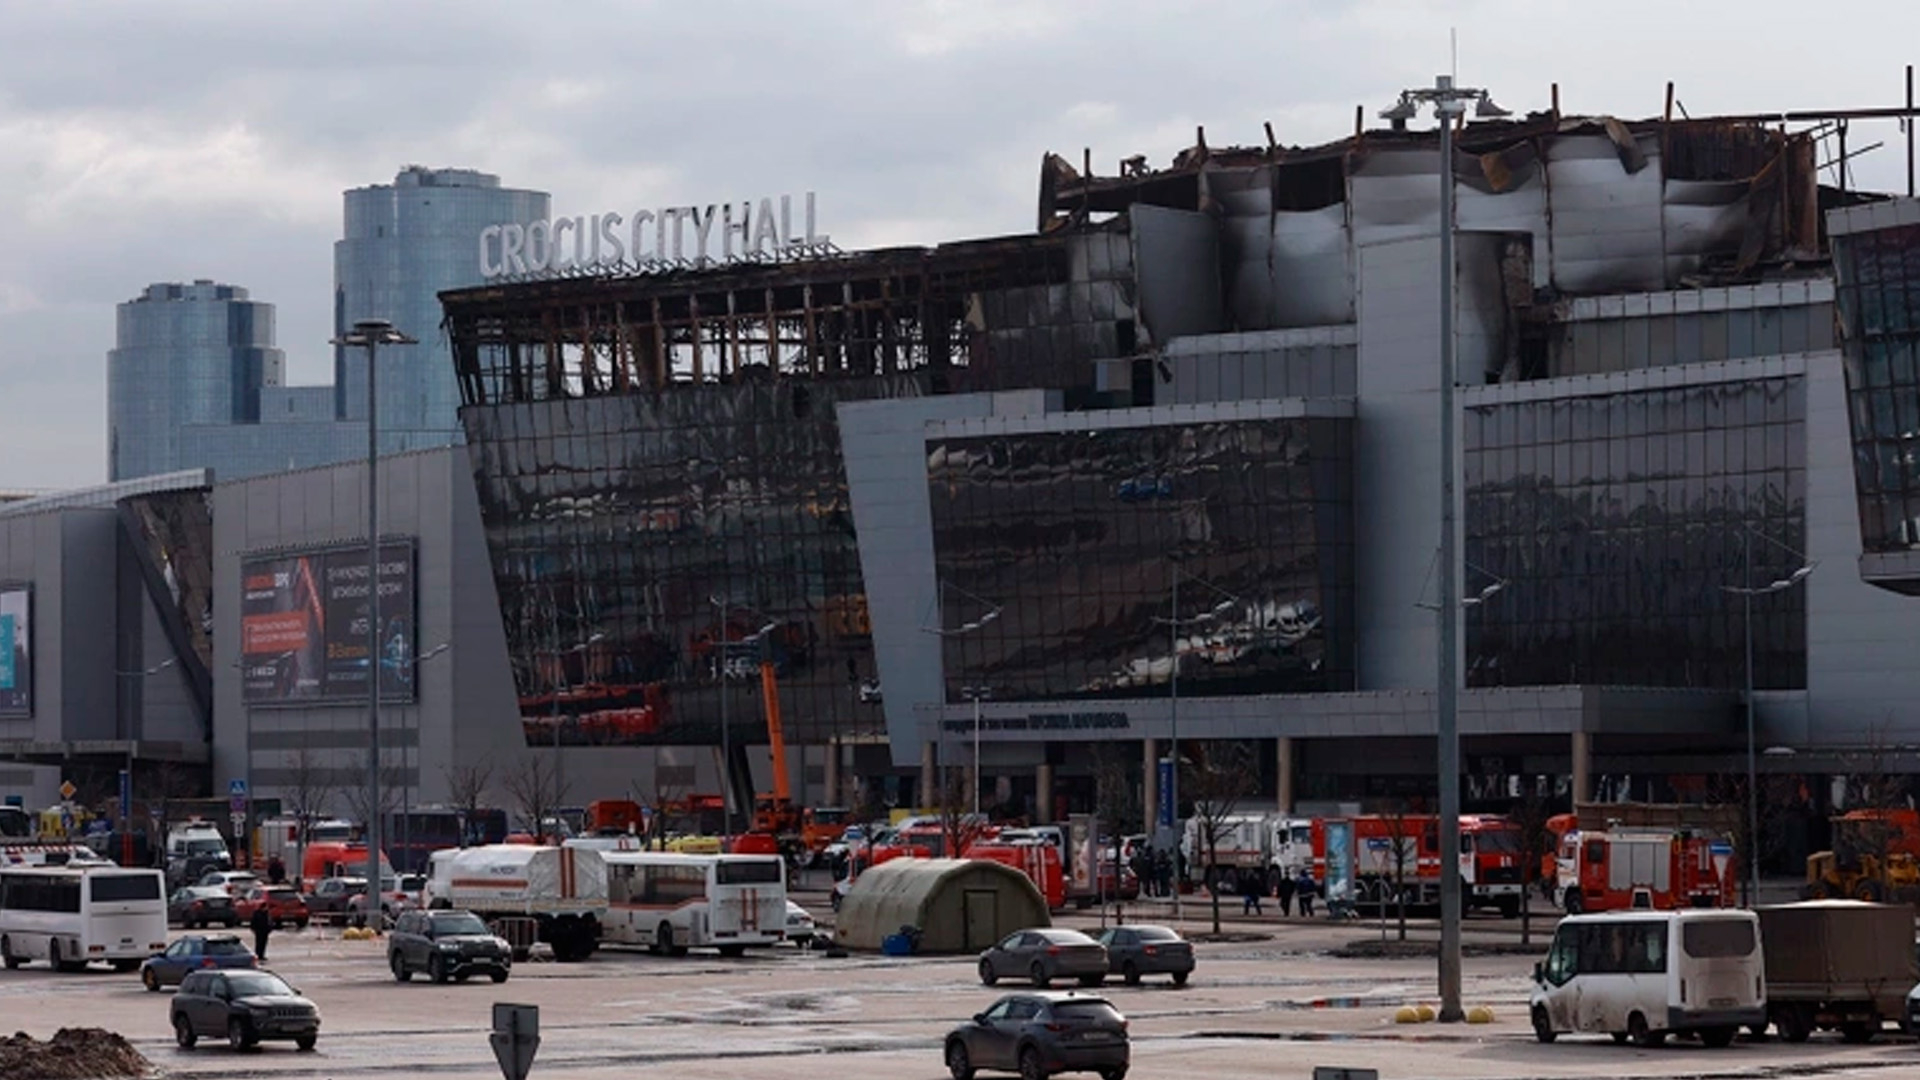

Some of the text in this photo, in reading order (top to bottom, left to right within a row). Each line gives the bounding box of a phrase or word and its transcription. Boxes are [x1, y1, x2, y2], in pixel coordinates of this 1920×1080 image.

[479, 191, 830, 277] CROCUS CITY HALL
